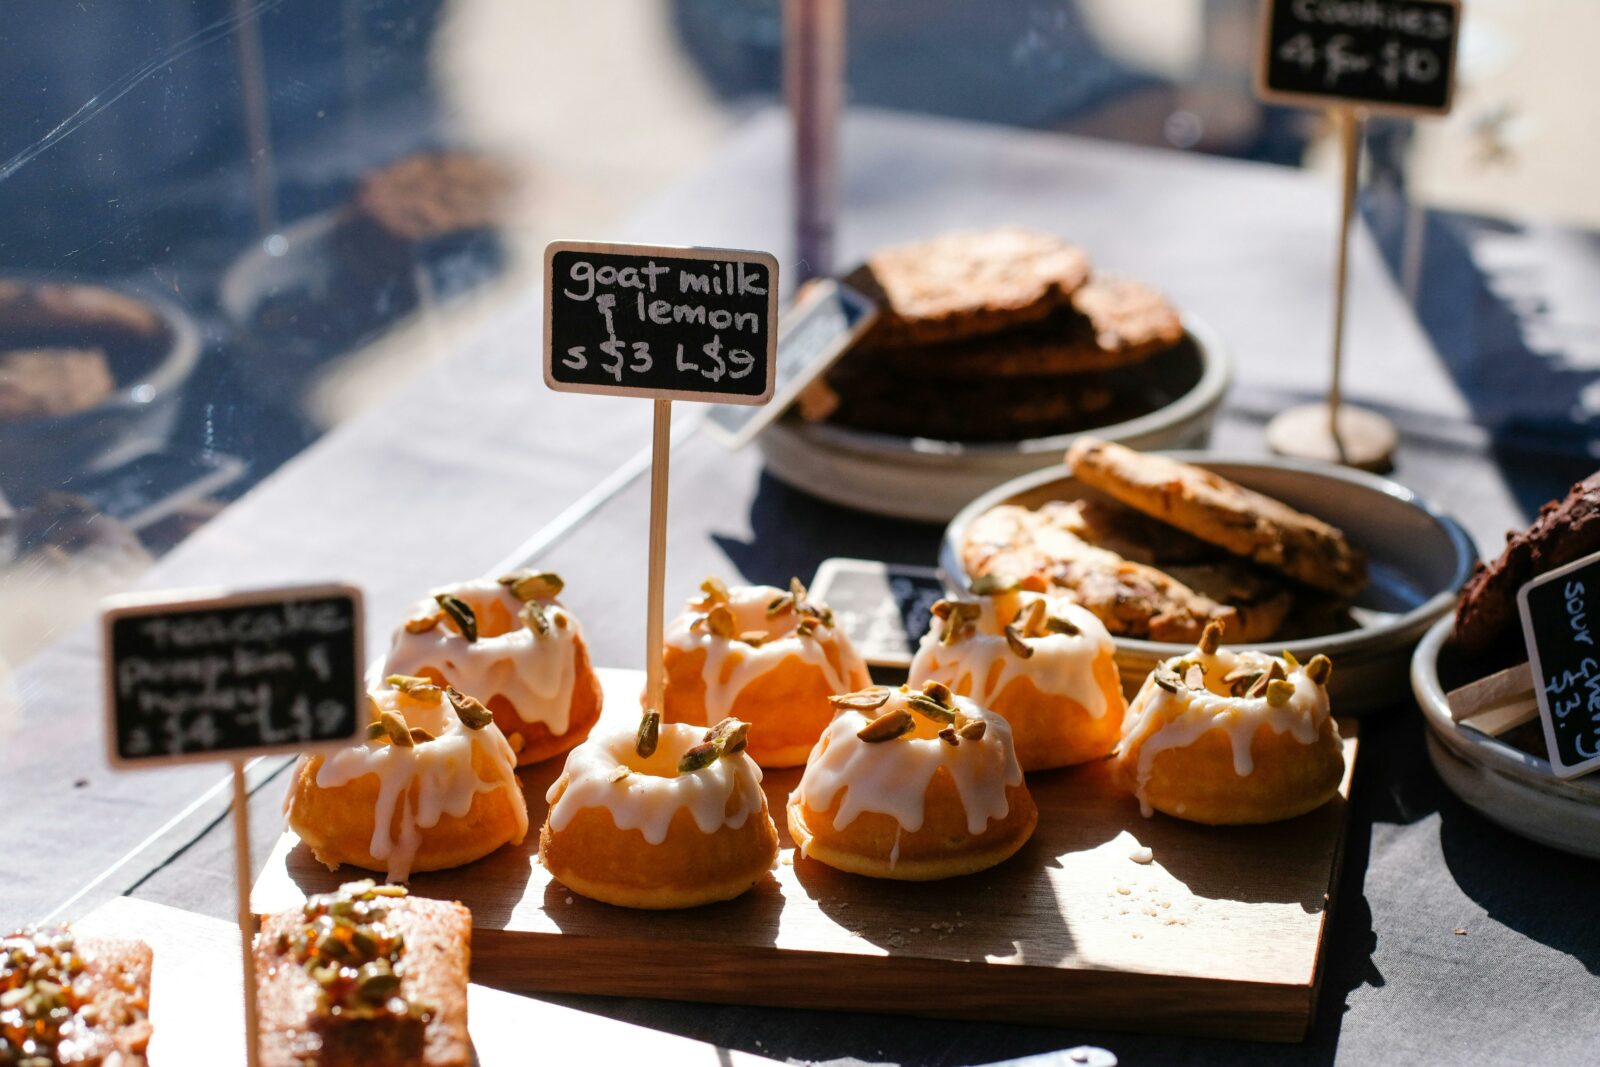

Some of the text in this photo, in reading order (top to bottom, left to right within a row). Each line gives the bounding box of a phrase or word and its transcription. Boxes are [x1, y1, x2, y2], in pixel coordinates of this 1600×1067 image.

[1280, 33, 1315, 70] 4
[564, 261, 768, 301] goat milk
[637, 291, 759, 334] lemon
[600, 334, 653, 382] $3
[1564, 581, 1594, 645] sour
